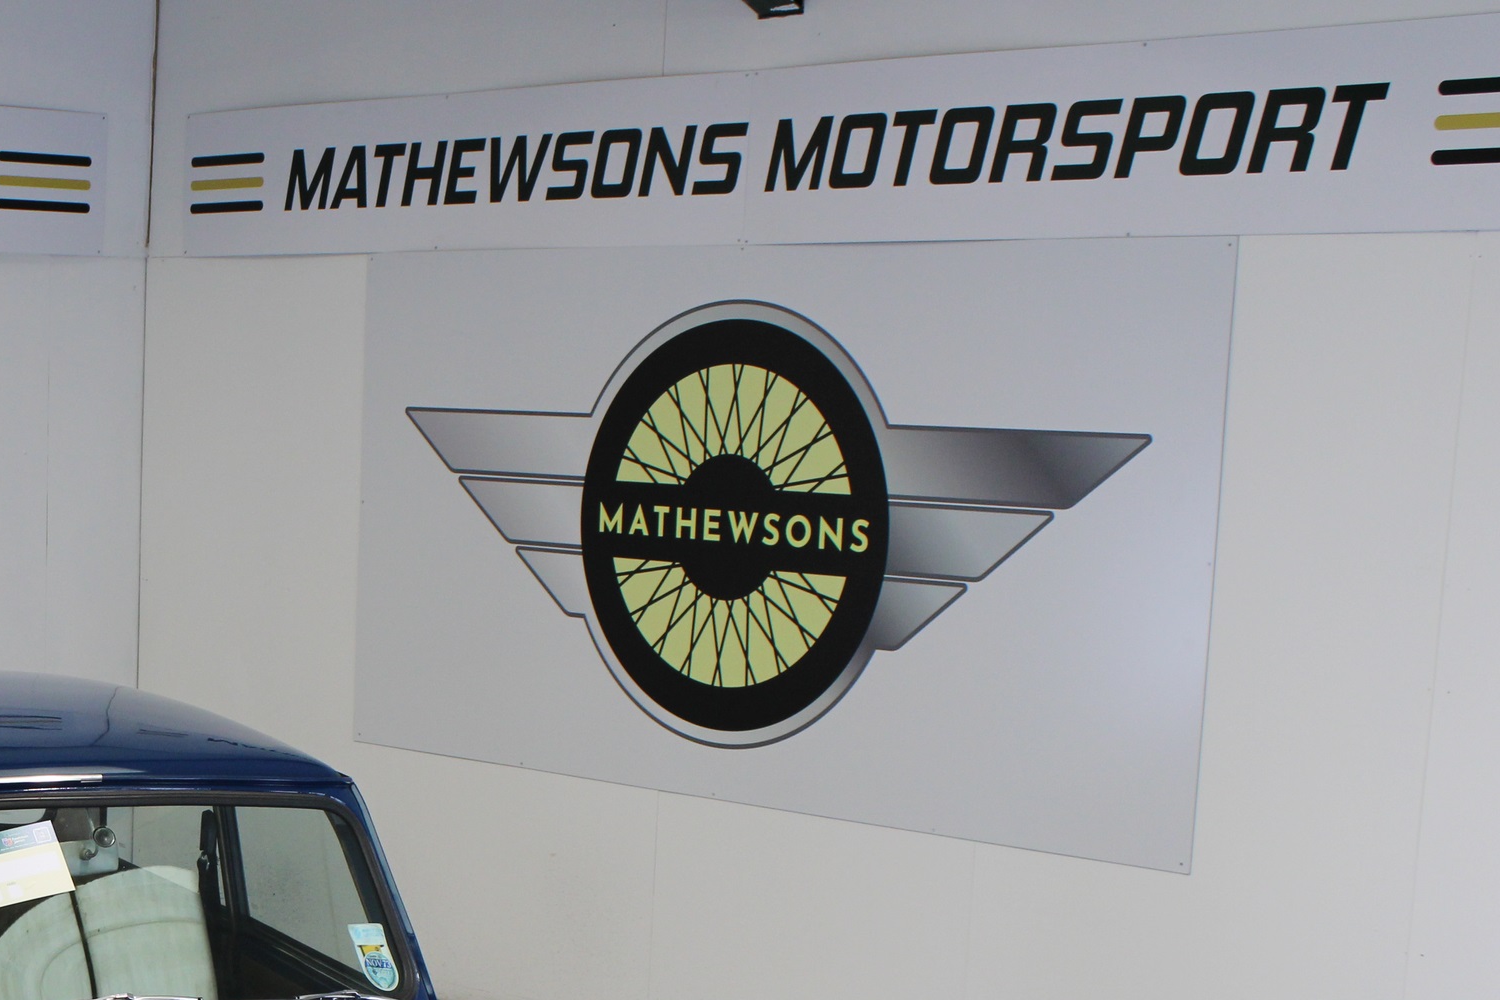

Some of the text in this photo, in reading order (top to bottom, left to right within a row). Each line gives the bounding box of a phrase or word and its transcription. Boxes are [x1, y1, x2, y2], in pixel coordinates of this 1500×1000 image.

[284, 82, 1391, 211] MATHEWSONS MOTORSPORT
[599, 501, 870, 554] MATHEWSONS
